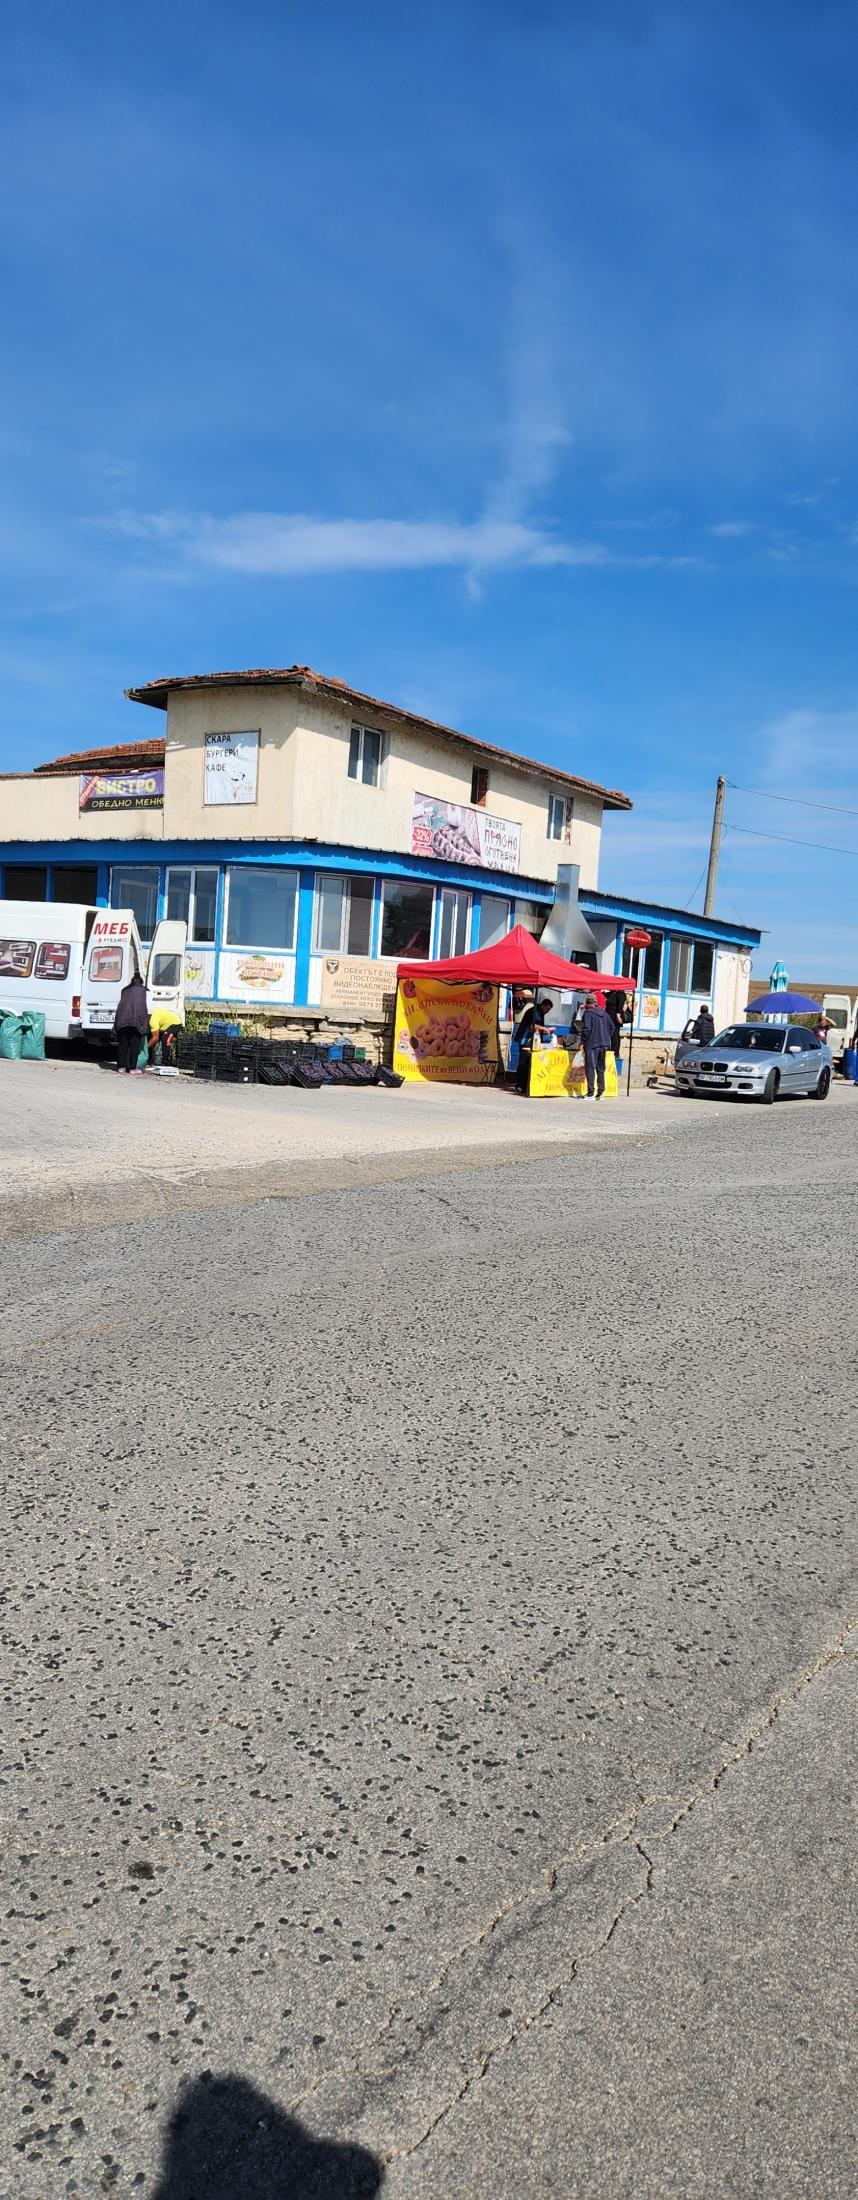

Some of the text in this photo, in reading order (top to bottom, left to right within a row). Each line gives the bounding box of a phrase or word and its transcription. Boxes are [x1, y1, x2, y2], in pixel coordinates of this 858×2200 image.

[206, 735, 232, 744] СКАРА
[206, 748, 239, 758] БУРГЕРИ
[205, 763, 226, 772] КАФЕ
[96, 778, 156, 795] БИСТРО
[91, 799, 132, 808] ОБЕДНО
[93, 922, 129, 935] МЕБ
[344, 967, 378, 976] ОБЕКТЪТ
[350, 975, 393, 984] ПОСТОЯННО
[333, 981, 397, 992] ВИДЕОНАБЛЮДЕН
